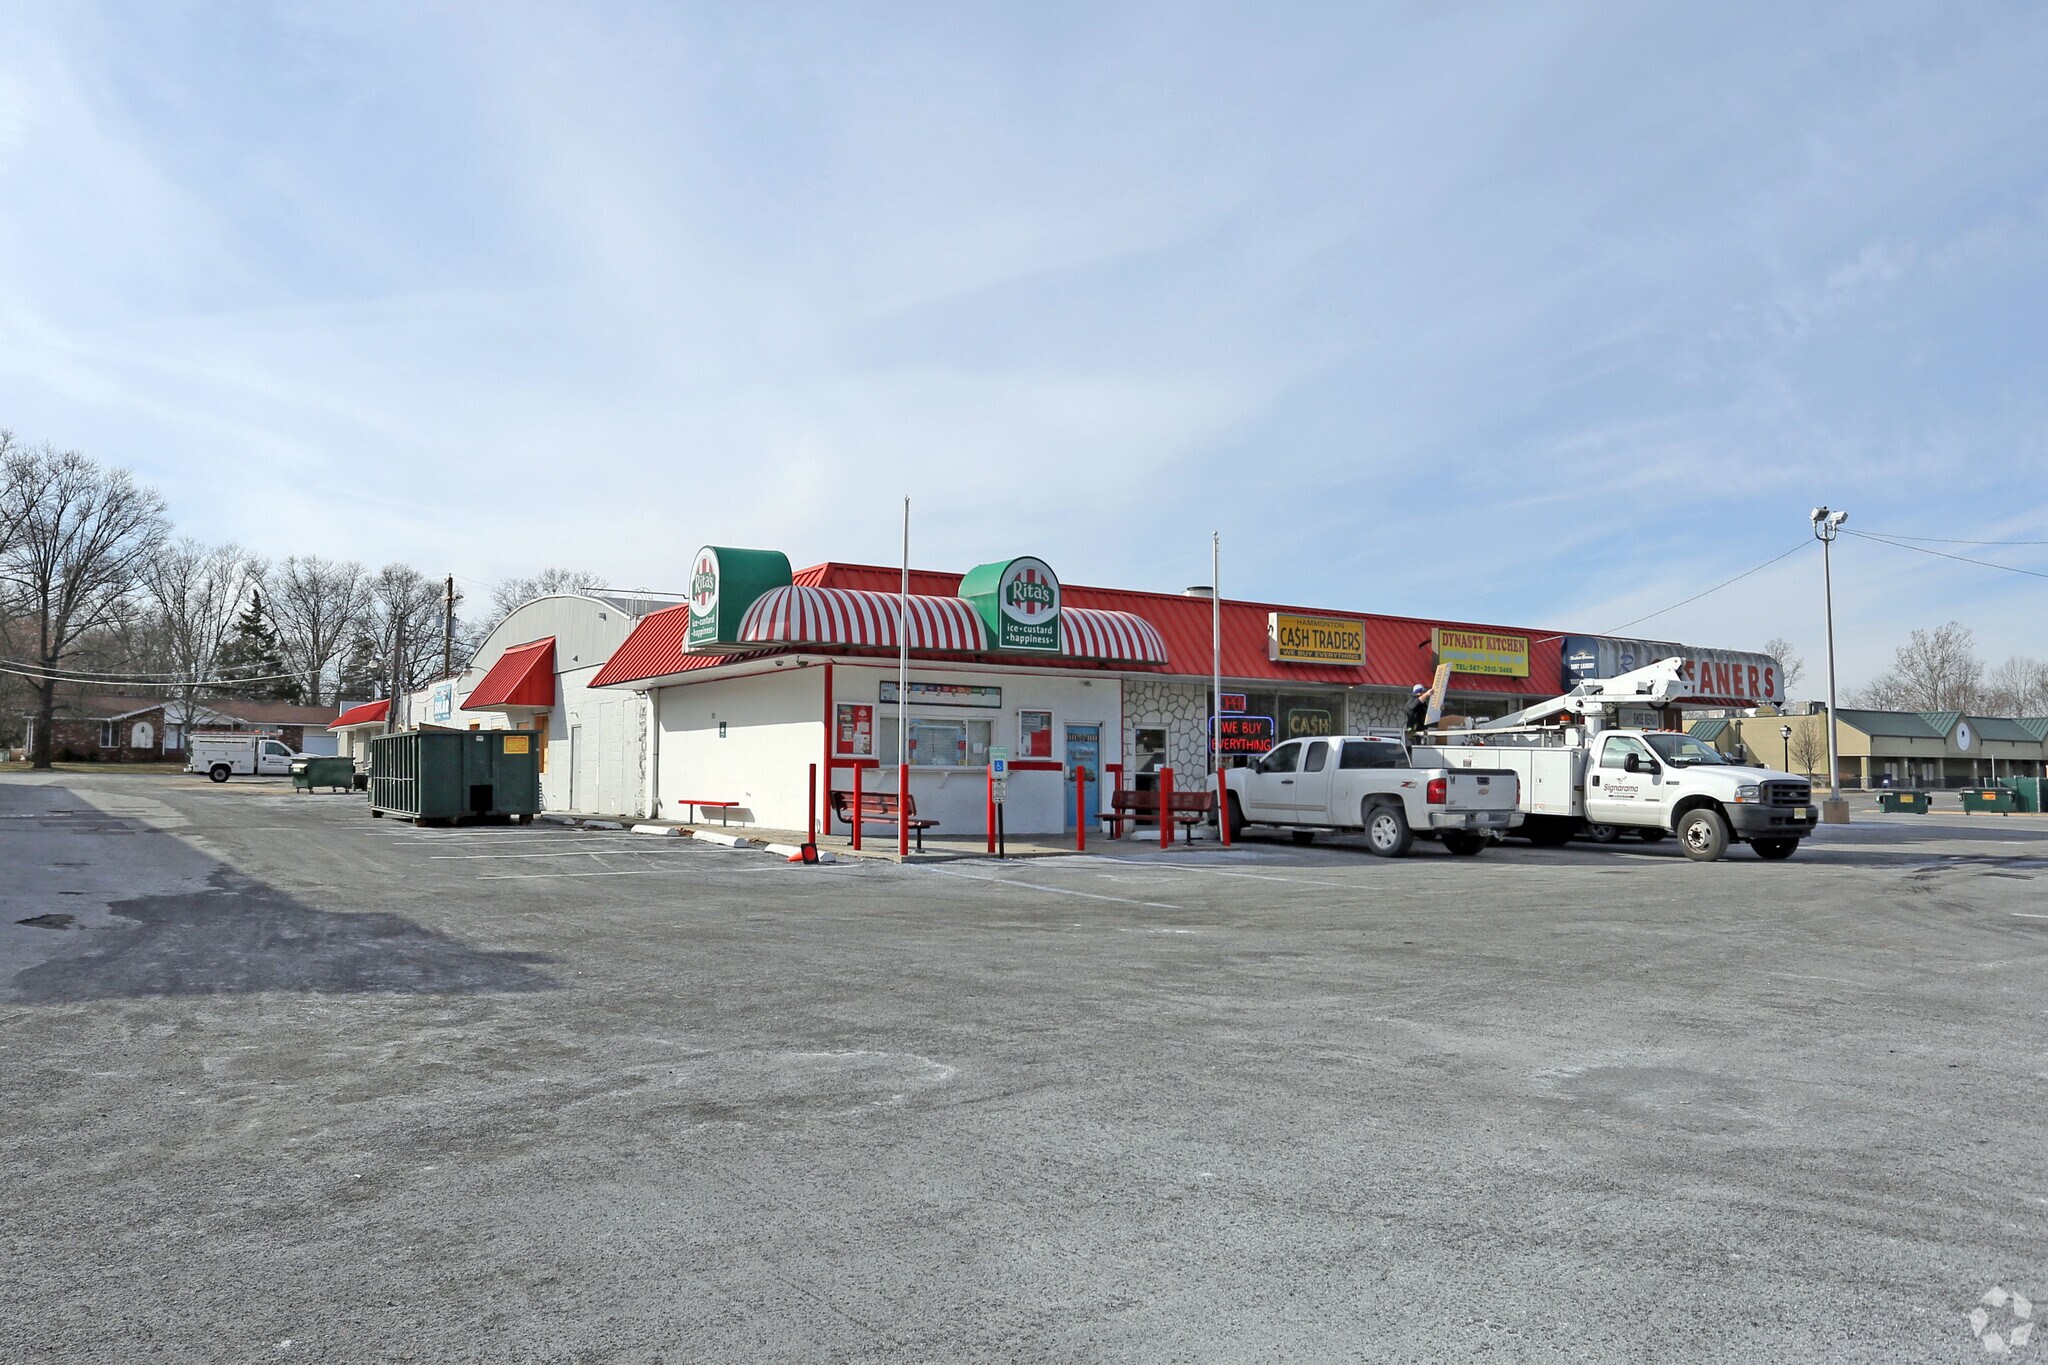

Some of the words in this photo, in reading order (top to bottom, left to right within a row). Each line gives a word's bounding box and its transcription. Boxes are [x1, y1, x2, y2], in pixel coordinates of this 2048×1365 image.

[694, 571, 714, 594] Rita's
[1012, 580, 1050, 602] Rita's
[1023, 626, 1053, 634] custard
[1296, 619, 1345, 629] HAMMONTON
[1010, 633, 1050, 644] happiness
[1280, 626, 1310, 649] CA$H
[1312, 629, 1361, 652] TRADER$
[1442, 632, 1484, 649] DYNASTY
[1486, 637, 1525, 653] KITCHEN
[1314, 651, 1360, 660] EVERYTHING
[1650, 657, 1775, 698] EANERS
[1219, 695, 1246, 711] OPEN
[1220, 721, 1238, 734] WE
[1242, 721, 1263, 734] BUY
[1603, 783, 1639, 794] Signarama
